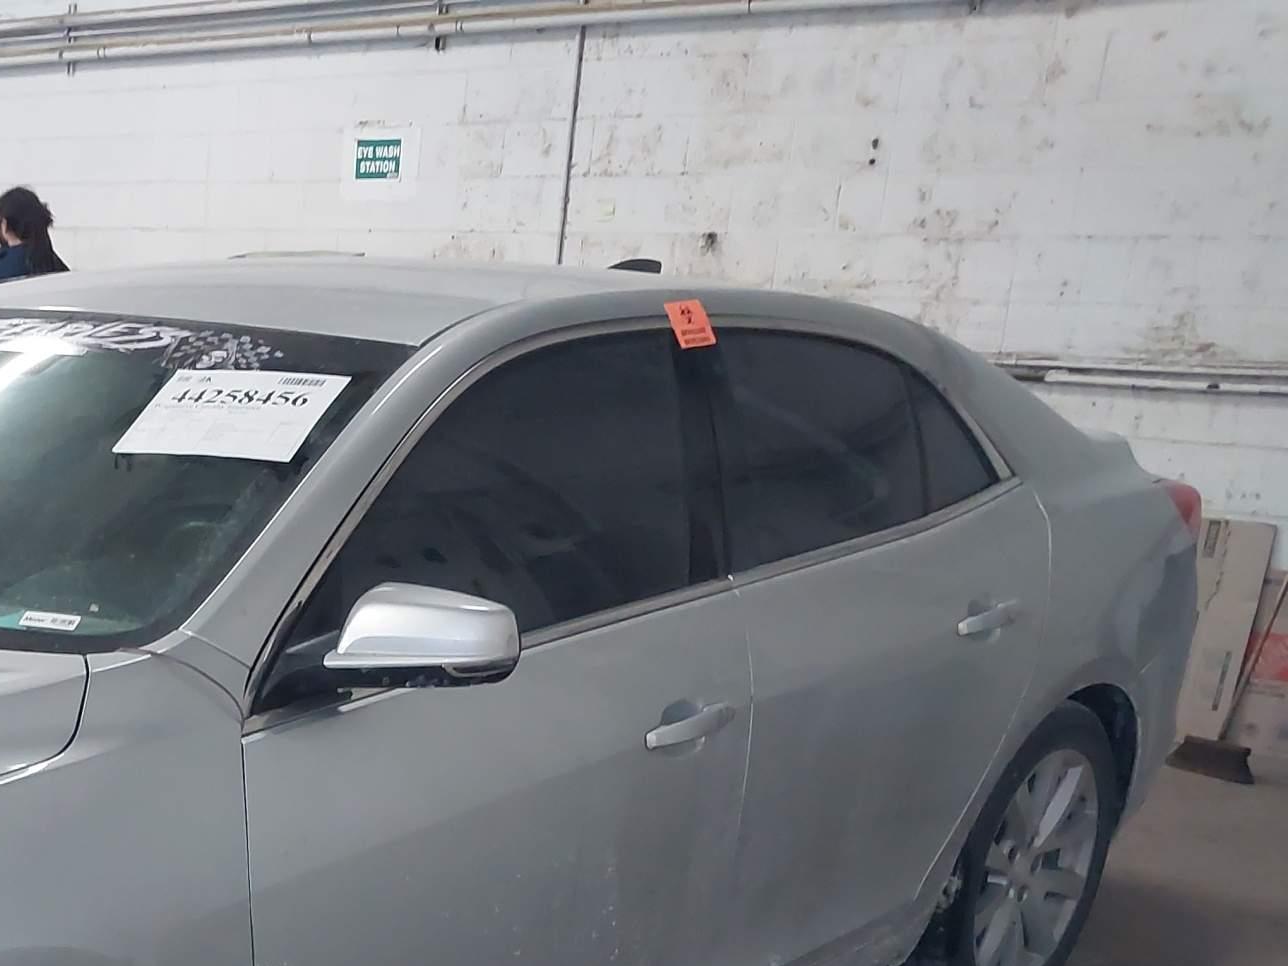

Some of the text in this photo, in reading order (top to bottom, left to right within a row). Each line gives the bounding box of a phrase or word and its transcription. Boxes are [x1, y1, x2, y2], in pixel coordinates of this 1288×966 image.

[357, 145, 400, 159] EYE WASH
[360, 160, 396, 173] STATION
[171, 388, 311, 407] 44258456
